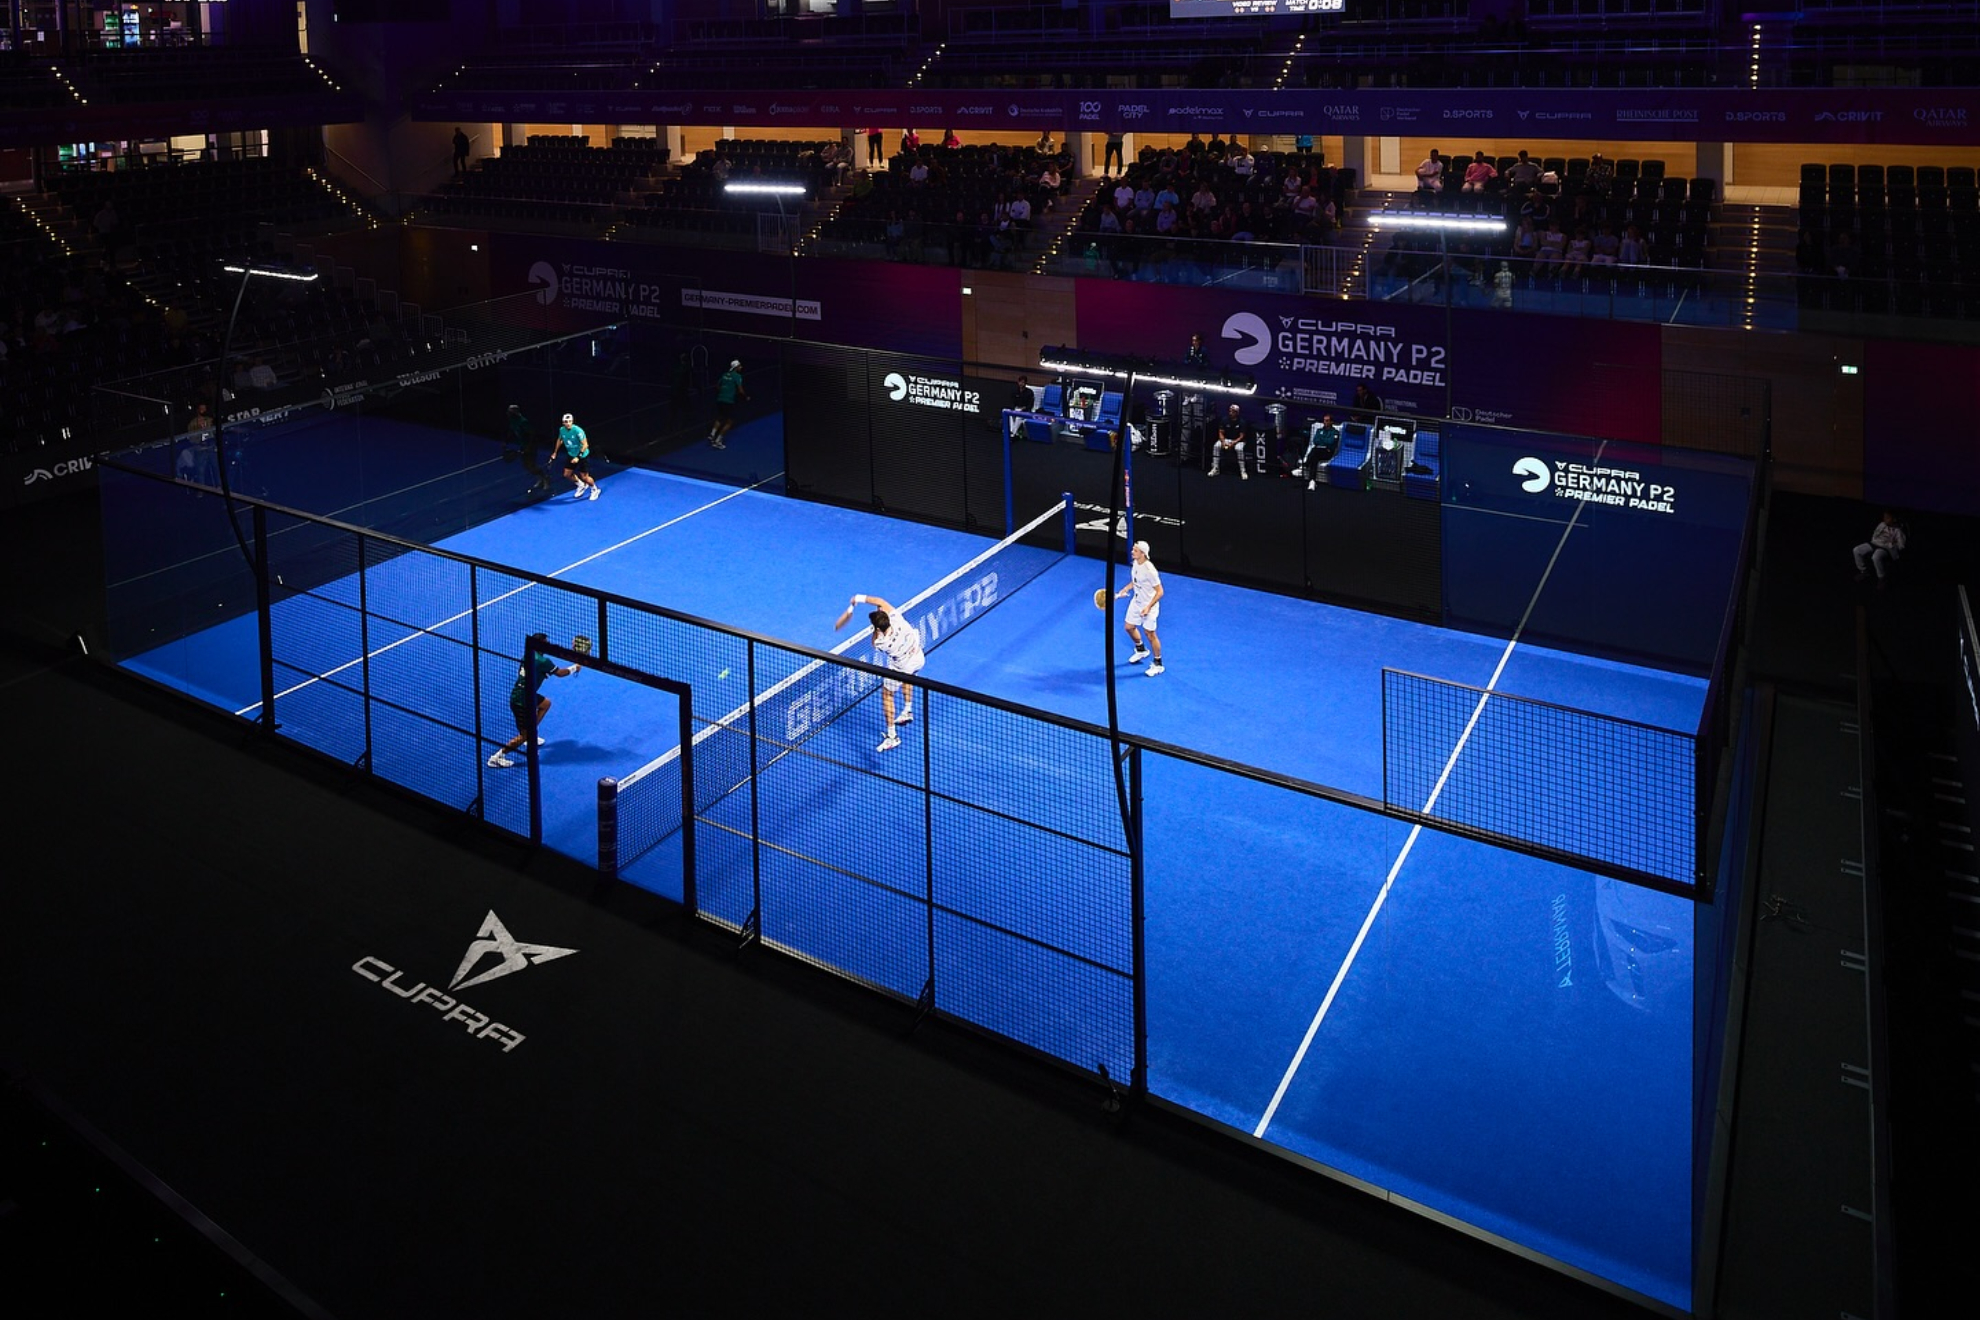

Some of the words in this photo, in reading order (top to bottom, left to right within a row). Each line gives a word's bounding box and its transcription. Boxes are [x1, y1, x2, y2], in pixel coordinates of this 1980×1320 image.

[1079, 101, 1101, 113] 100
[1118, 104, 1150, 113] PADEL
[1323, 105, 1359, 115] QATAR
[1443, 109, 1493, 119] D.SPORTS
[1672, 109, 1699, 119] POST
[1913, 107, 1967, 120] QATAR
[1123, 111, 1143, 119] CITY
[1535, 111, 1592, 119] CUPRA
[1725, 111, 1786, 122] D.SPORTS
[1836, 111, 1884, 122] CRIVIT
[1925, 119, 1968, 127] AIRWAYS
[573, 265, 631, 279] CUPRA
[562, 276, 636, 300] GERMANY
[639, 283, 660, 303] P2
[571, 297, 620, 314] PREMIER
[1297, 318, 1396, 338] CUPRA
[1278, 332, 1404, 363] GERMANY
[1411, 344, 1446, 369] P2
[1292, 357, 1376, 379] PREMIER
[1382, 366, 1446, 387] PADEL
[916, 376, 960, 389] CUPRA
[908, 383, 962, 402] GERMANY
[964, 390, 980, 405] P2
[915, 396, 951, 410] PREMIER
[952, 401, 980, 413] PADEL
[53, 452, 104, 477] CRIV
[1568, 463, 1640, 481] CUPRA
[1554, 471, 1646, 497] GERMANY
[1650, 484, 1675, 502] P2
[1564, 488, 1626, 506] PREMIER
[1629, 497, 1675, 514] PADEL
[352, 955, 528, 1054] CUPRA
